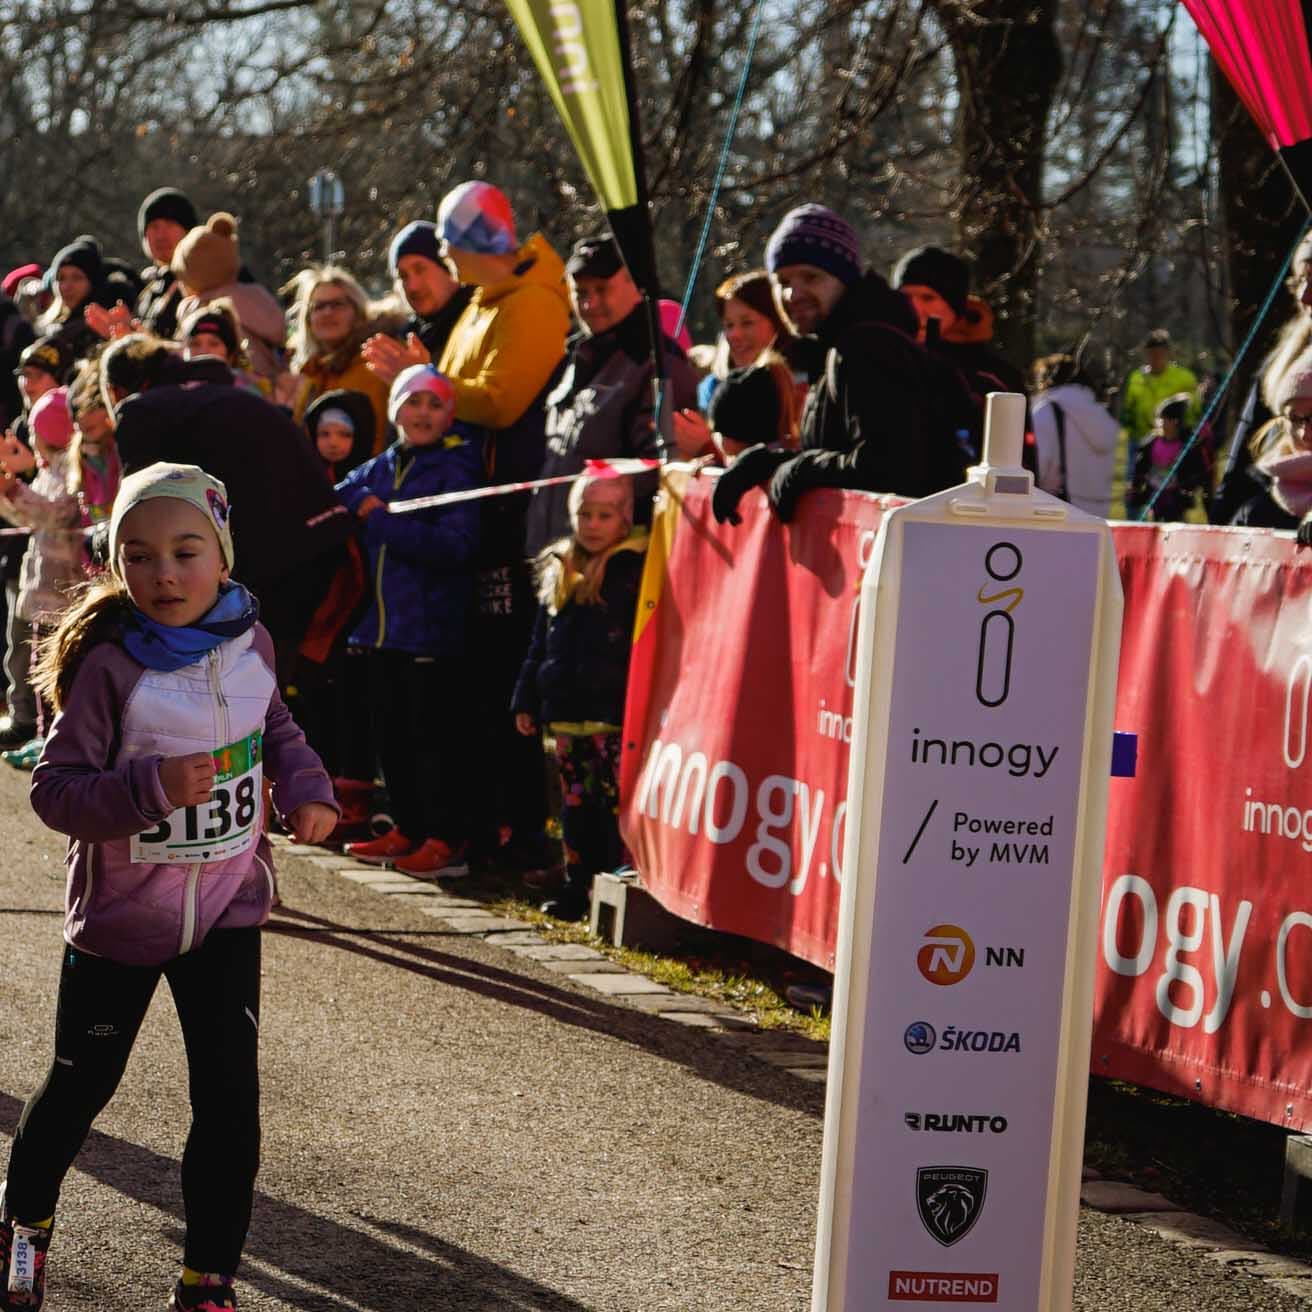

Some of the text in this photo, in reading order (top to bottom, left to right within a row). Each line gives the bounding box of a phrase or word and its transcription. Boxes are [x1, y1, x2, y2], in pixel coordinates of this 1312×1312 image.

[911, 727, 1059, 778] innogy
[954, 812, 1055, 837] Powered
[951, 840, 1049, 867] by MVM
[985, 946, 1025, 968] NN
[940, 1025, 1022, 1054] ŠKODA
[923, 1113, 1008, 1134] RUNTO
[894, 1276, 994, 1298] NUTREND
